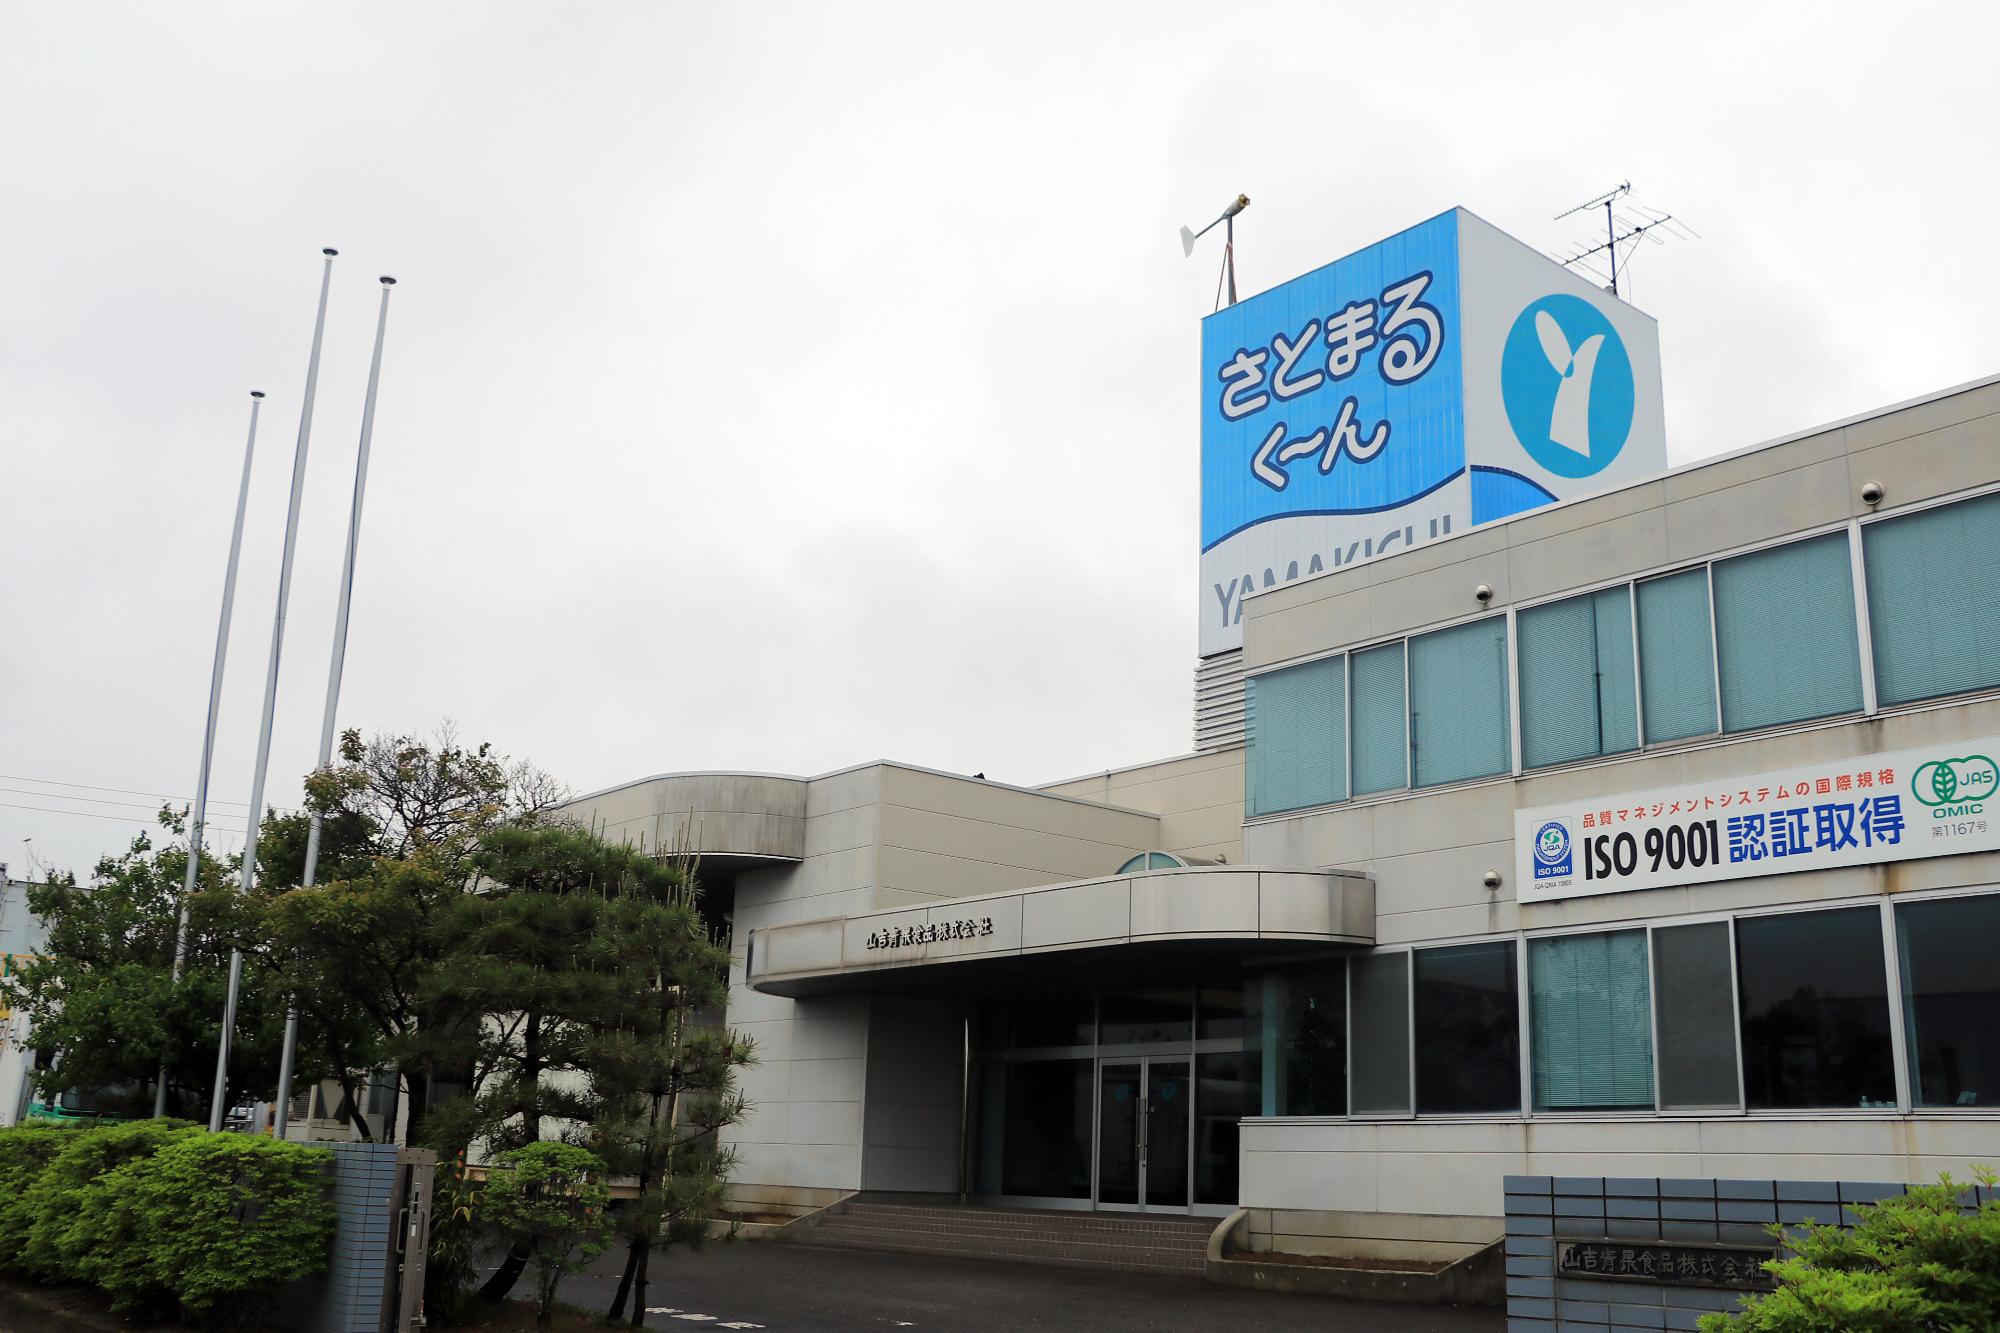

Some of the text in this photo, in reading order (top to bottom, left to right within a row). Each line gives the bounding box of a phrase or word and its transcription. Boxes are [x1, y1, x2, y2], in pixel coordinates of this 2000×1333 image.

[1219, 270, 1444, 422] さとまる
[1583, 768, 1896, 828] 品質マネジメントシステムの国際規格
[1960, 770, 1993, 786] JAS
[1727, 795, 1904, 863] 認証取得
[1932, 821, 1988, 837] 第1167号
[1933, 804, 1983, 818] OMIC
[1584, 819, 1720, 880] ISO 9001
